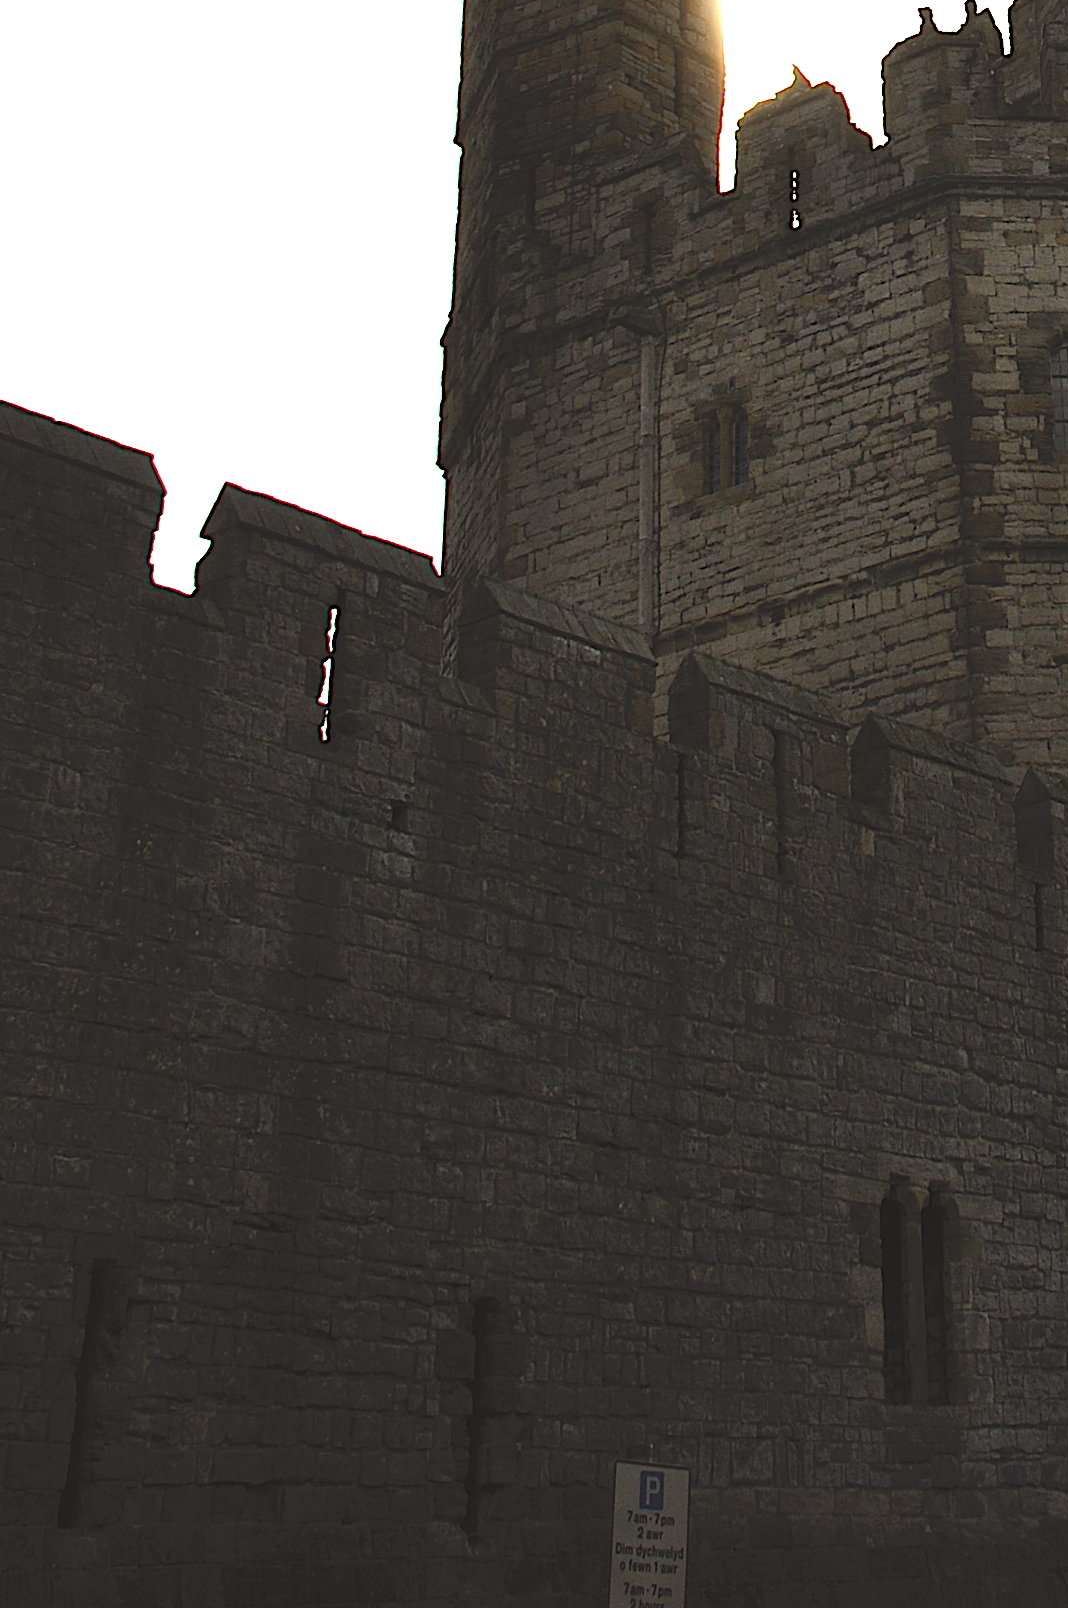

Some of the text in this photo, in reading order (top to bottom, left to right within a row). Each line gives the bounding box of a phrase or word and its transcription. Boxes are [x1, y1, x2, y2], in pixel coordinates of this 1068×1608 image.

[646, 1476, 660, 1505] P
[637, 1526, 664, 1540] 2 awr
[615, 1542, 684, 1561] Dim dychwelyd
[619, 1561, 626, 1571] o
[628, 1559, 651, 1572] fewn
[661, 1564, 678, 1574] awr
